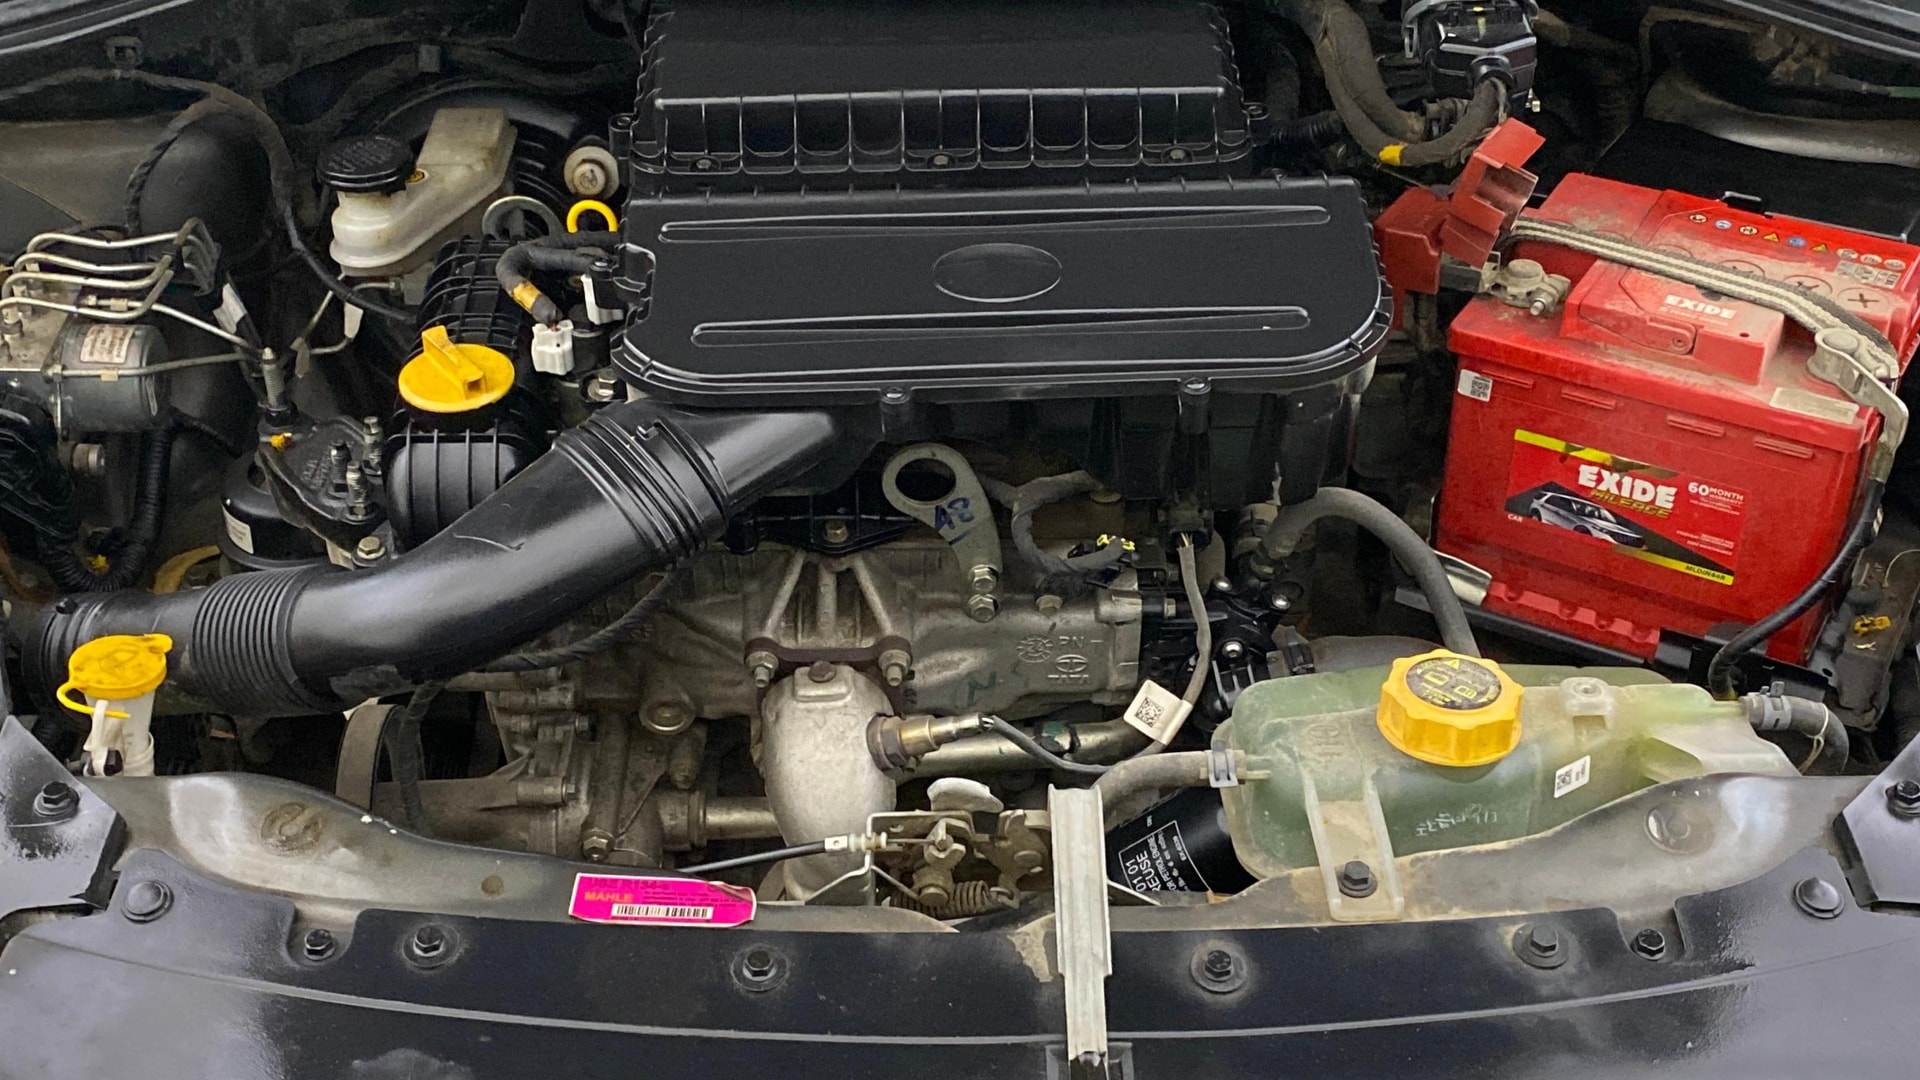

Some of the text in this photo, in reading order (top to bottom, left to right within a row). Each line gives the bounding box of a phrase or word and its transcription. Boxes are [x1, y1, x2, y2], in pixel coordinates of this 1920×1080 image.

[1664, 294, 1737, 319] EXIDE
[1578, 464, 1678, 510] EXIDE
[1688, 482, 1744, 502] 60 MONTH
[1589, 489, 1673, 519] MILEAGE
[1507, 513, 1523, 523] CAR
[584, 891, 634, 904] MAHLE
